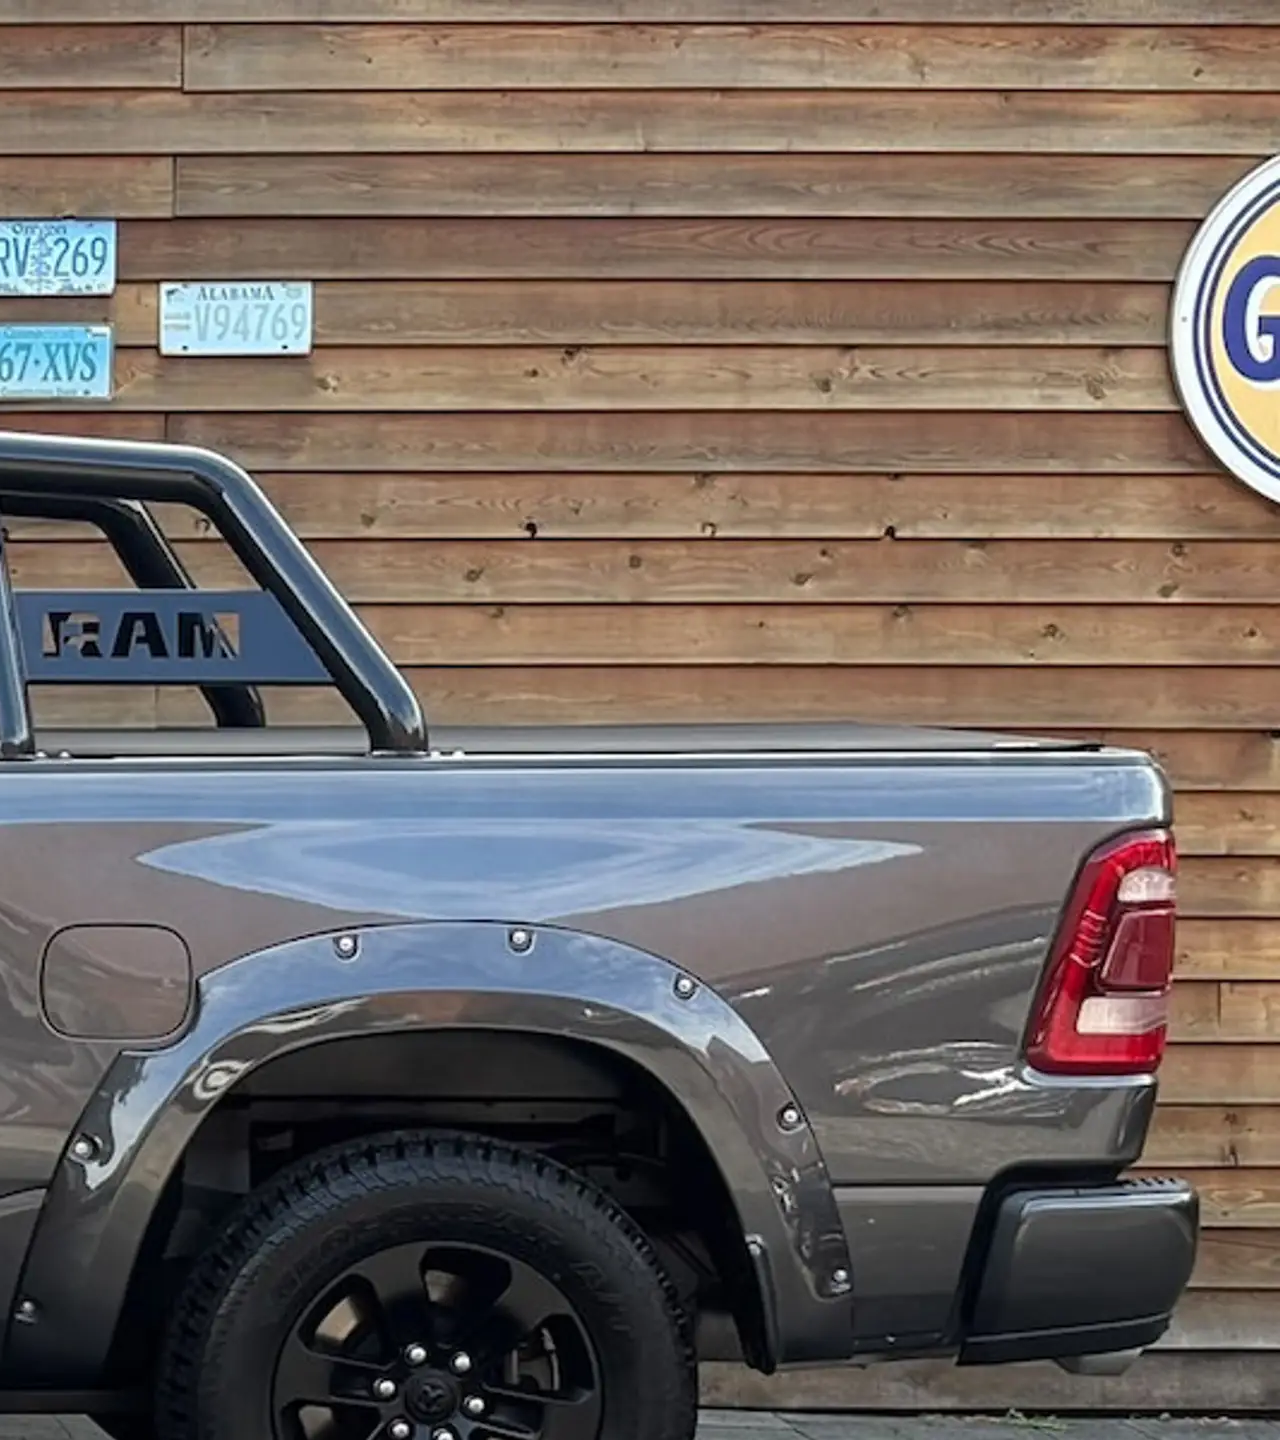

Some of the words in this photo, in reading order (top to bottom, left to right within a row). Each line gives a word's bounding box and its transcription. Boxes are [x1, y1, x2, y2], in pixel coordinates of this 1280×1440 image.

[52, 237, 109, 277] 269
[194, 303, 307, 341] V94769
[43, 612, 239, 658] RAM
